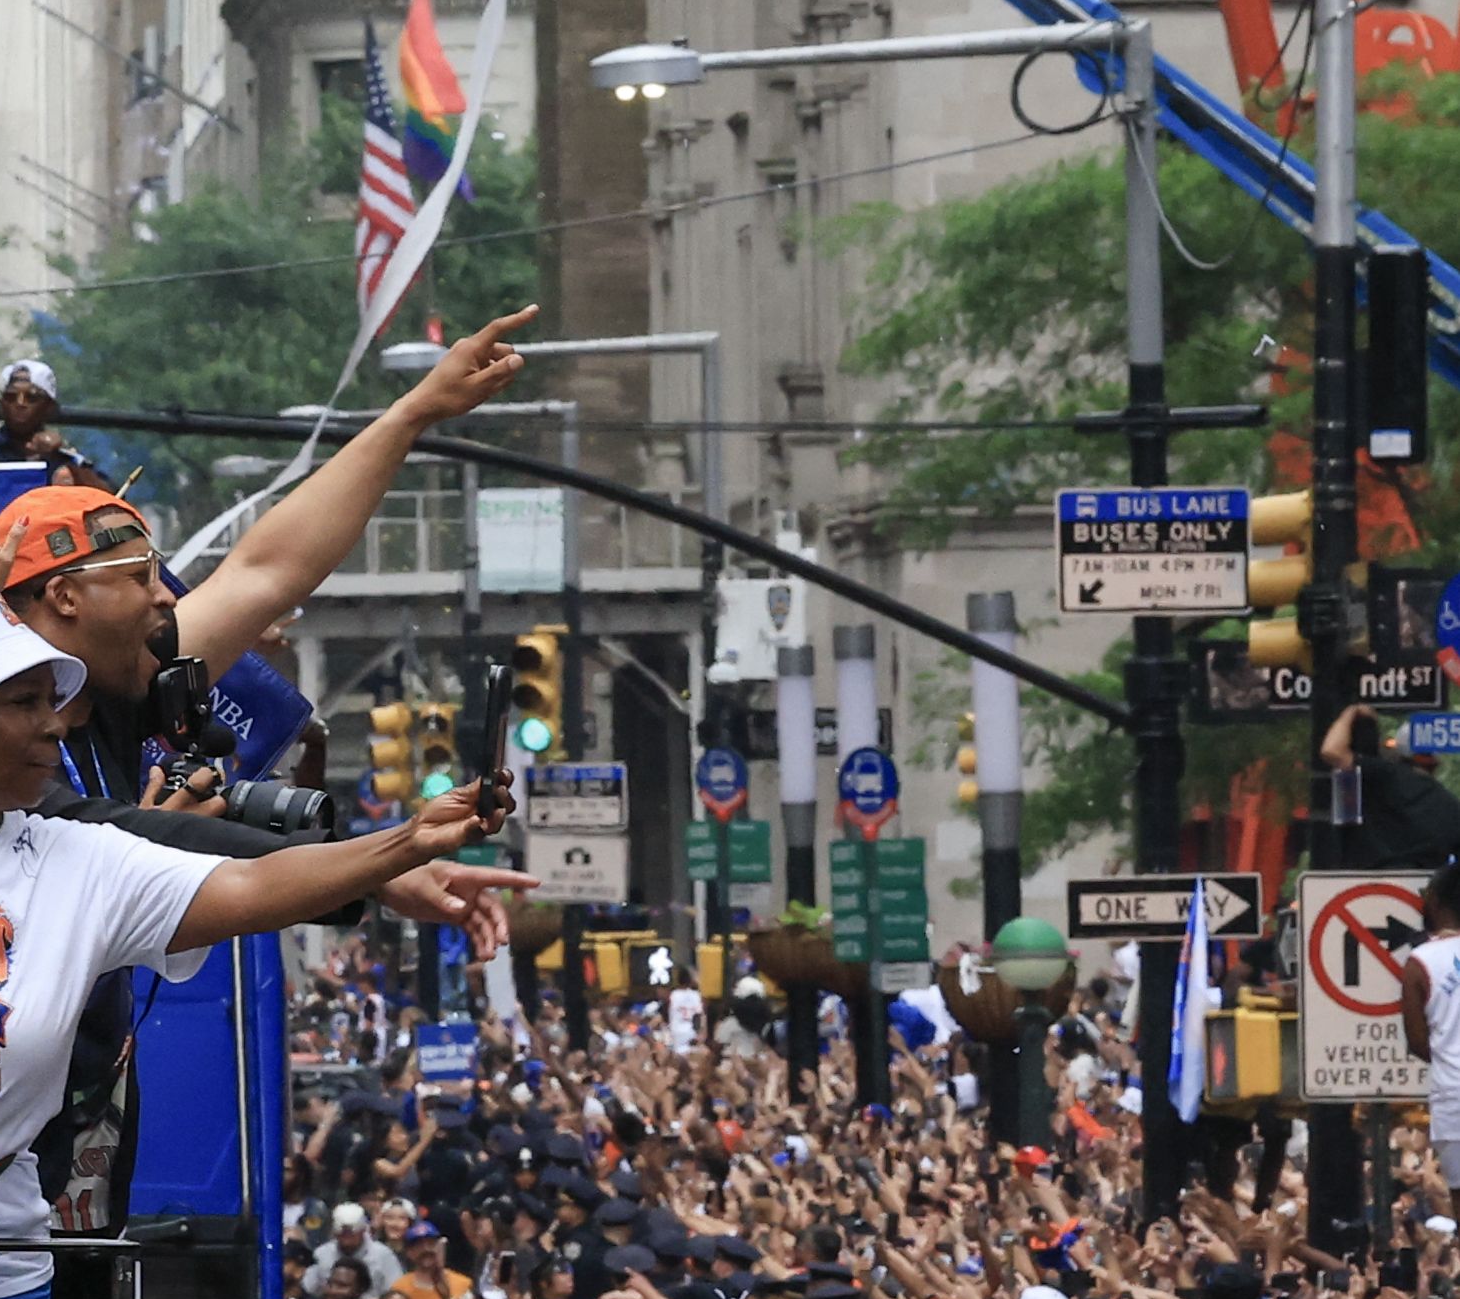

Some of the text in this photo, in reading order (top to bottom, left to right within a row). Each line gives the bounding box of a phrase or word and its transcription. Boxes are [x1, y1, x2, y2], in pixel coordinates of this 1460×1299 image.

[1117, 495, 1231, 516] BUS LANE
[1073, 521, 1233, 543] BUSES ONLY
[1140, 586, 1174, 600] MON
[1411, 667, 1432, 685] ST
[208, 685, 254, 741] NBA
[1413, 718, 1460, 748] M55
[1095, 896, 1147, 922] ONE
[1355, 1023, 1398, 1041] FOR
[1314, 1068, 1371, 1086] OVER
[1381, 1067, 1408, 1085] 45
